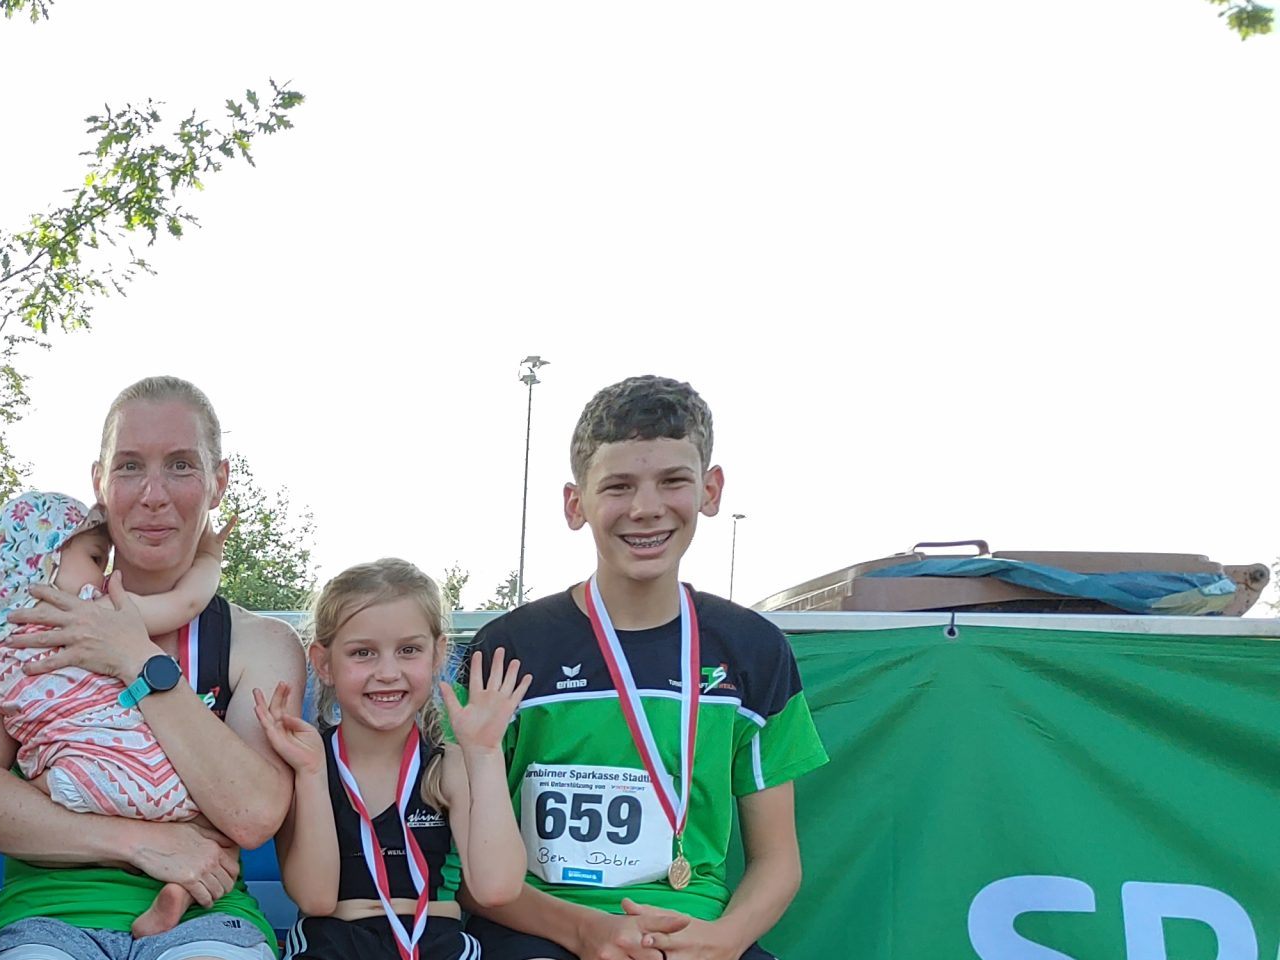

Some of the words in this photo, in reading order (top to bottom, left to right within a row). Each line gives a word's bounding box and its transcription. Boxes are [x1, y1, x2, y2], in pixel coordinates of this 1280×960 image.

[556, 677, 587, 690] erima
[569, 769, 620, 781] Sparkasse
[622, 772, 653, 784] Stadtl
[535, 791, 643, 845] 659
[536, 847, 568, 864] Ben
[585, 851, 640, 866] Dobler
